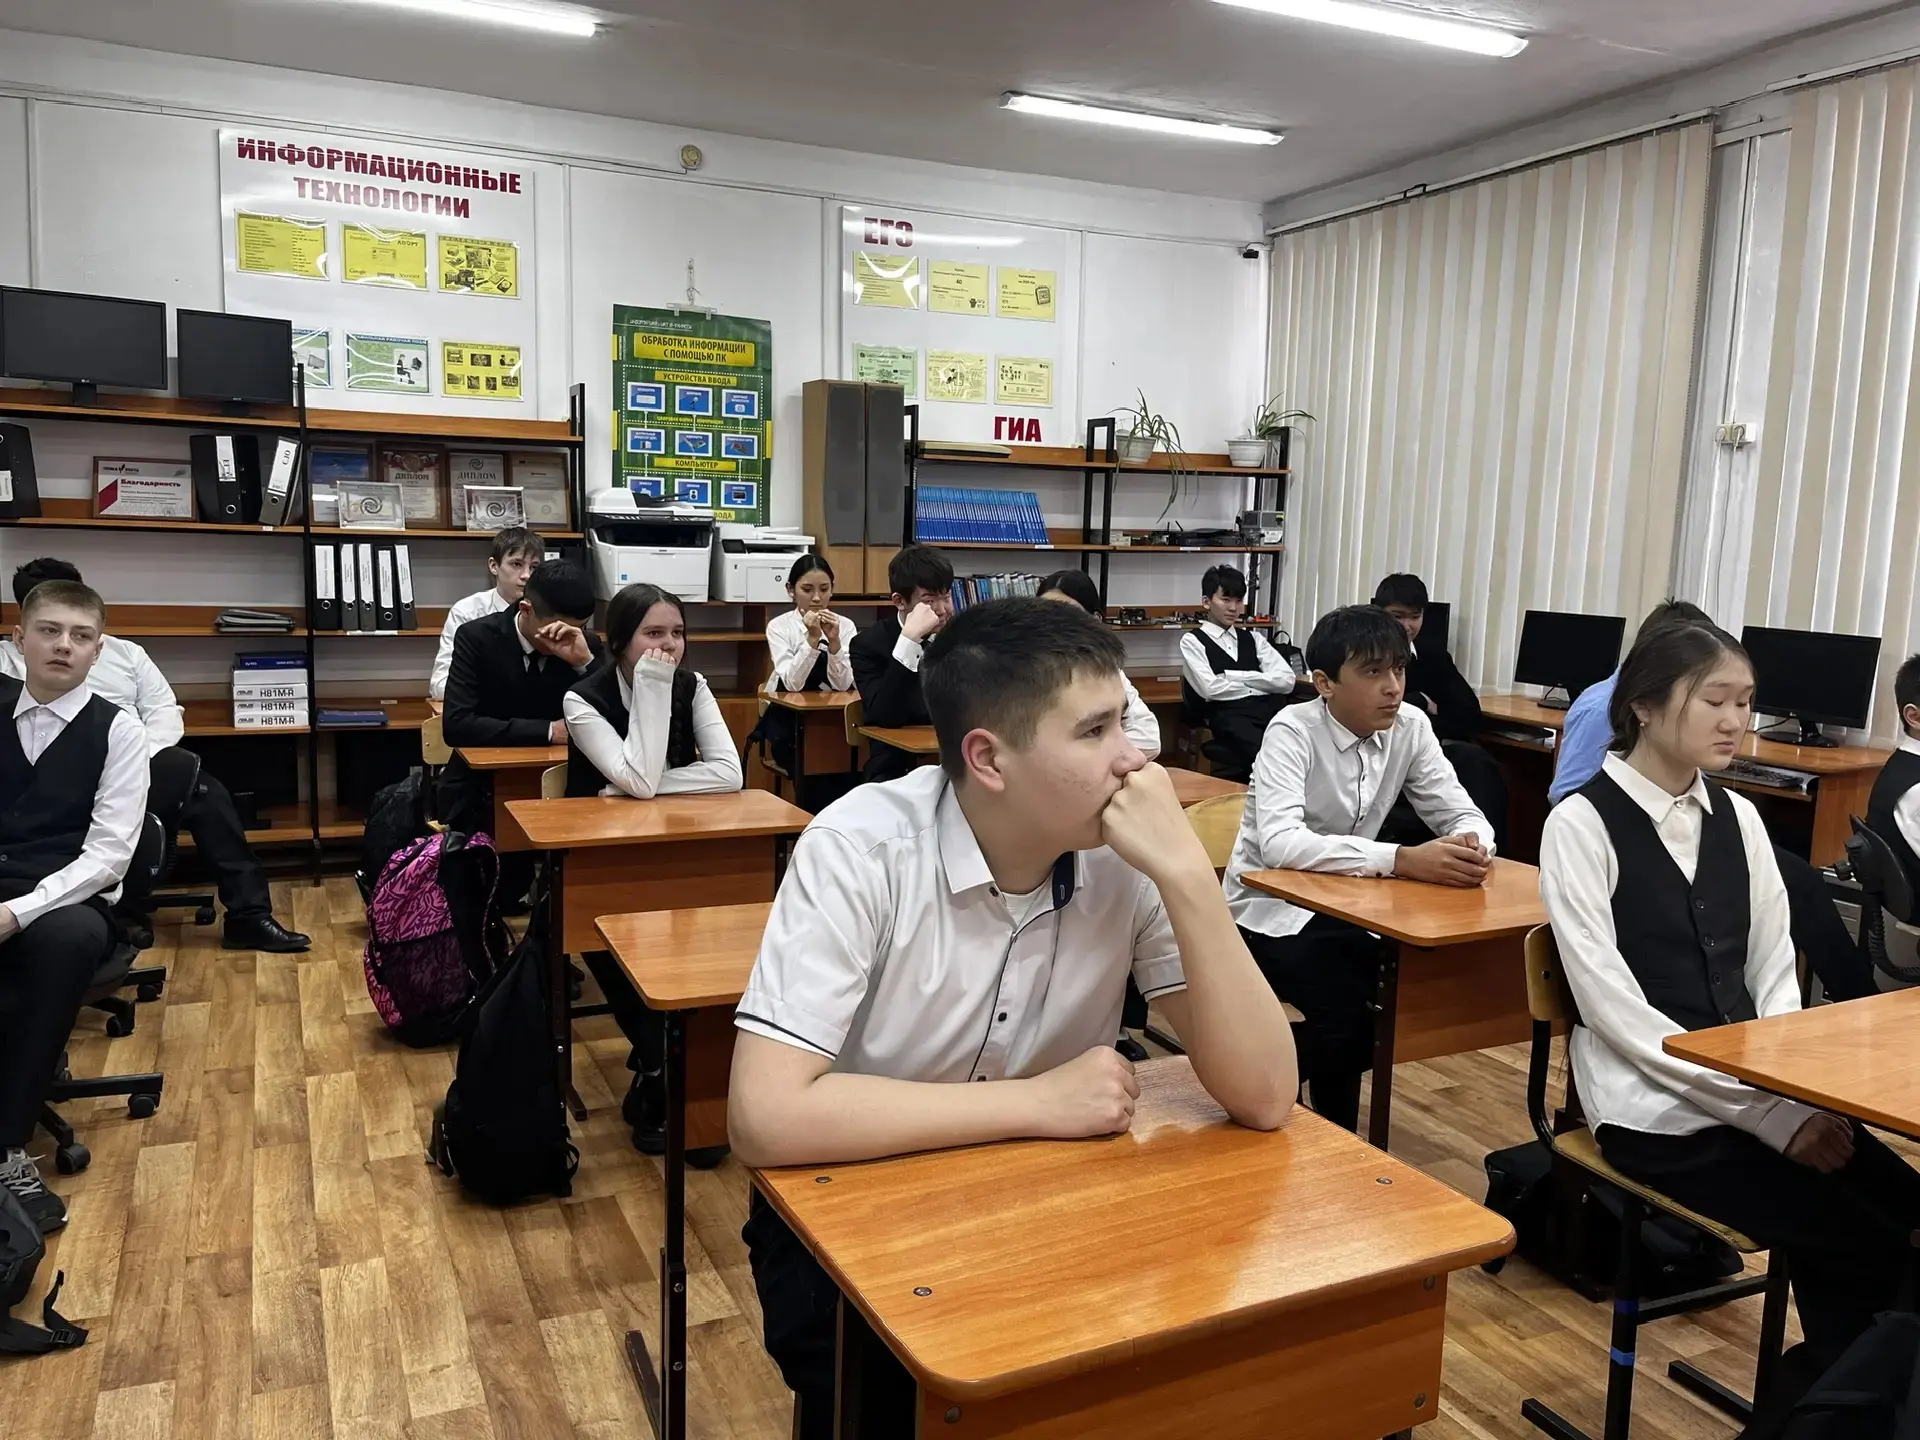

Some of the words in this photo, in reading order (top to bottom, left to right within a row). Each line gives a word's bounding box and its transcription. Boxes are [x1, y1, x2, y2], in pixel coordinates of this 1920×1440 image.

[237, 137, 521, 194] ИНФОРМАЦИОННЫЕ
[293, 176, 471, 219] ТЕХНОЛОГИИ
[641, 335, 688, 348] ОБРАБОТКА
[689, 340, 746, 354] ИНФОРМАЦИИ
[663, 348, 668, 358] С
[669, 349, 715, 363] ПОМОЩЬЮ
[716, 353, 727, 363] ПК
[663, 372, 706, 383] УСТРОЙСТВА
[708, 376, 731, 385] ВВОДА
[994, 416, 1042, 442] ГИА
[675, 460, 718, 469] КОМПЬЮТЕР
[395, 472, 430, 480] ДИПЛОМ
[457, 472, 496, 480] ДИПЛОМ
[121, 479, 181, 487] Благодарность
[260, 689, 294, 697] H81M-R
[261, 702, 295, 710] H81M-R
[261, 717, 295, 725] H81M-R
